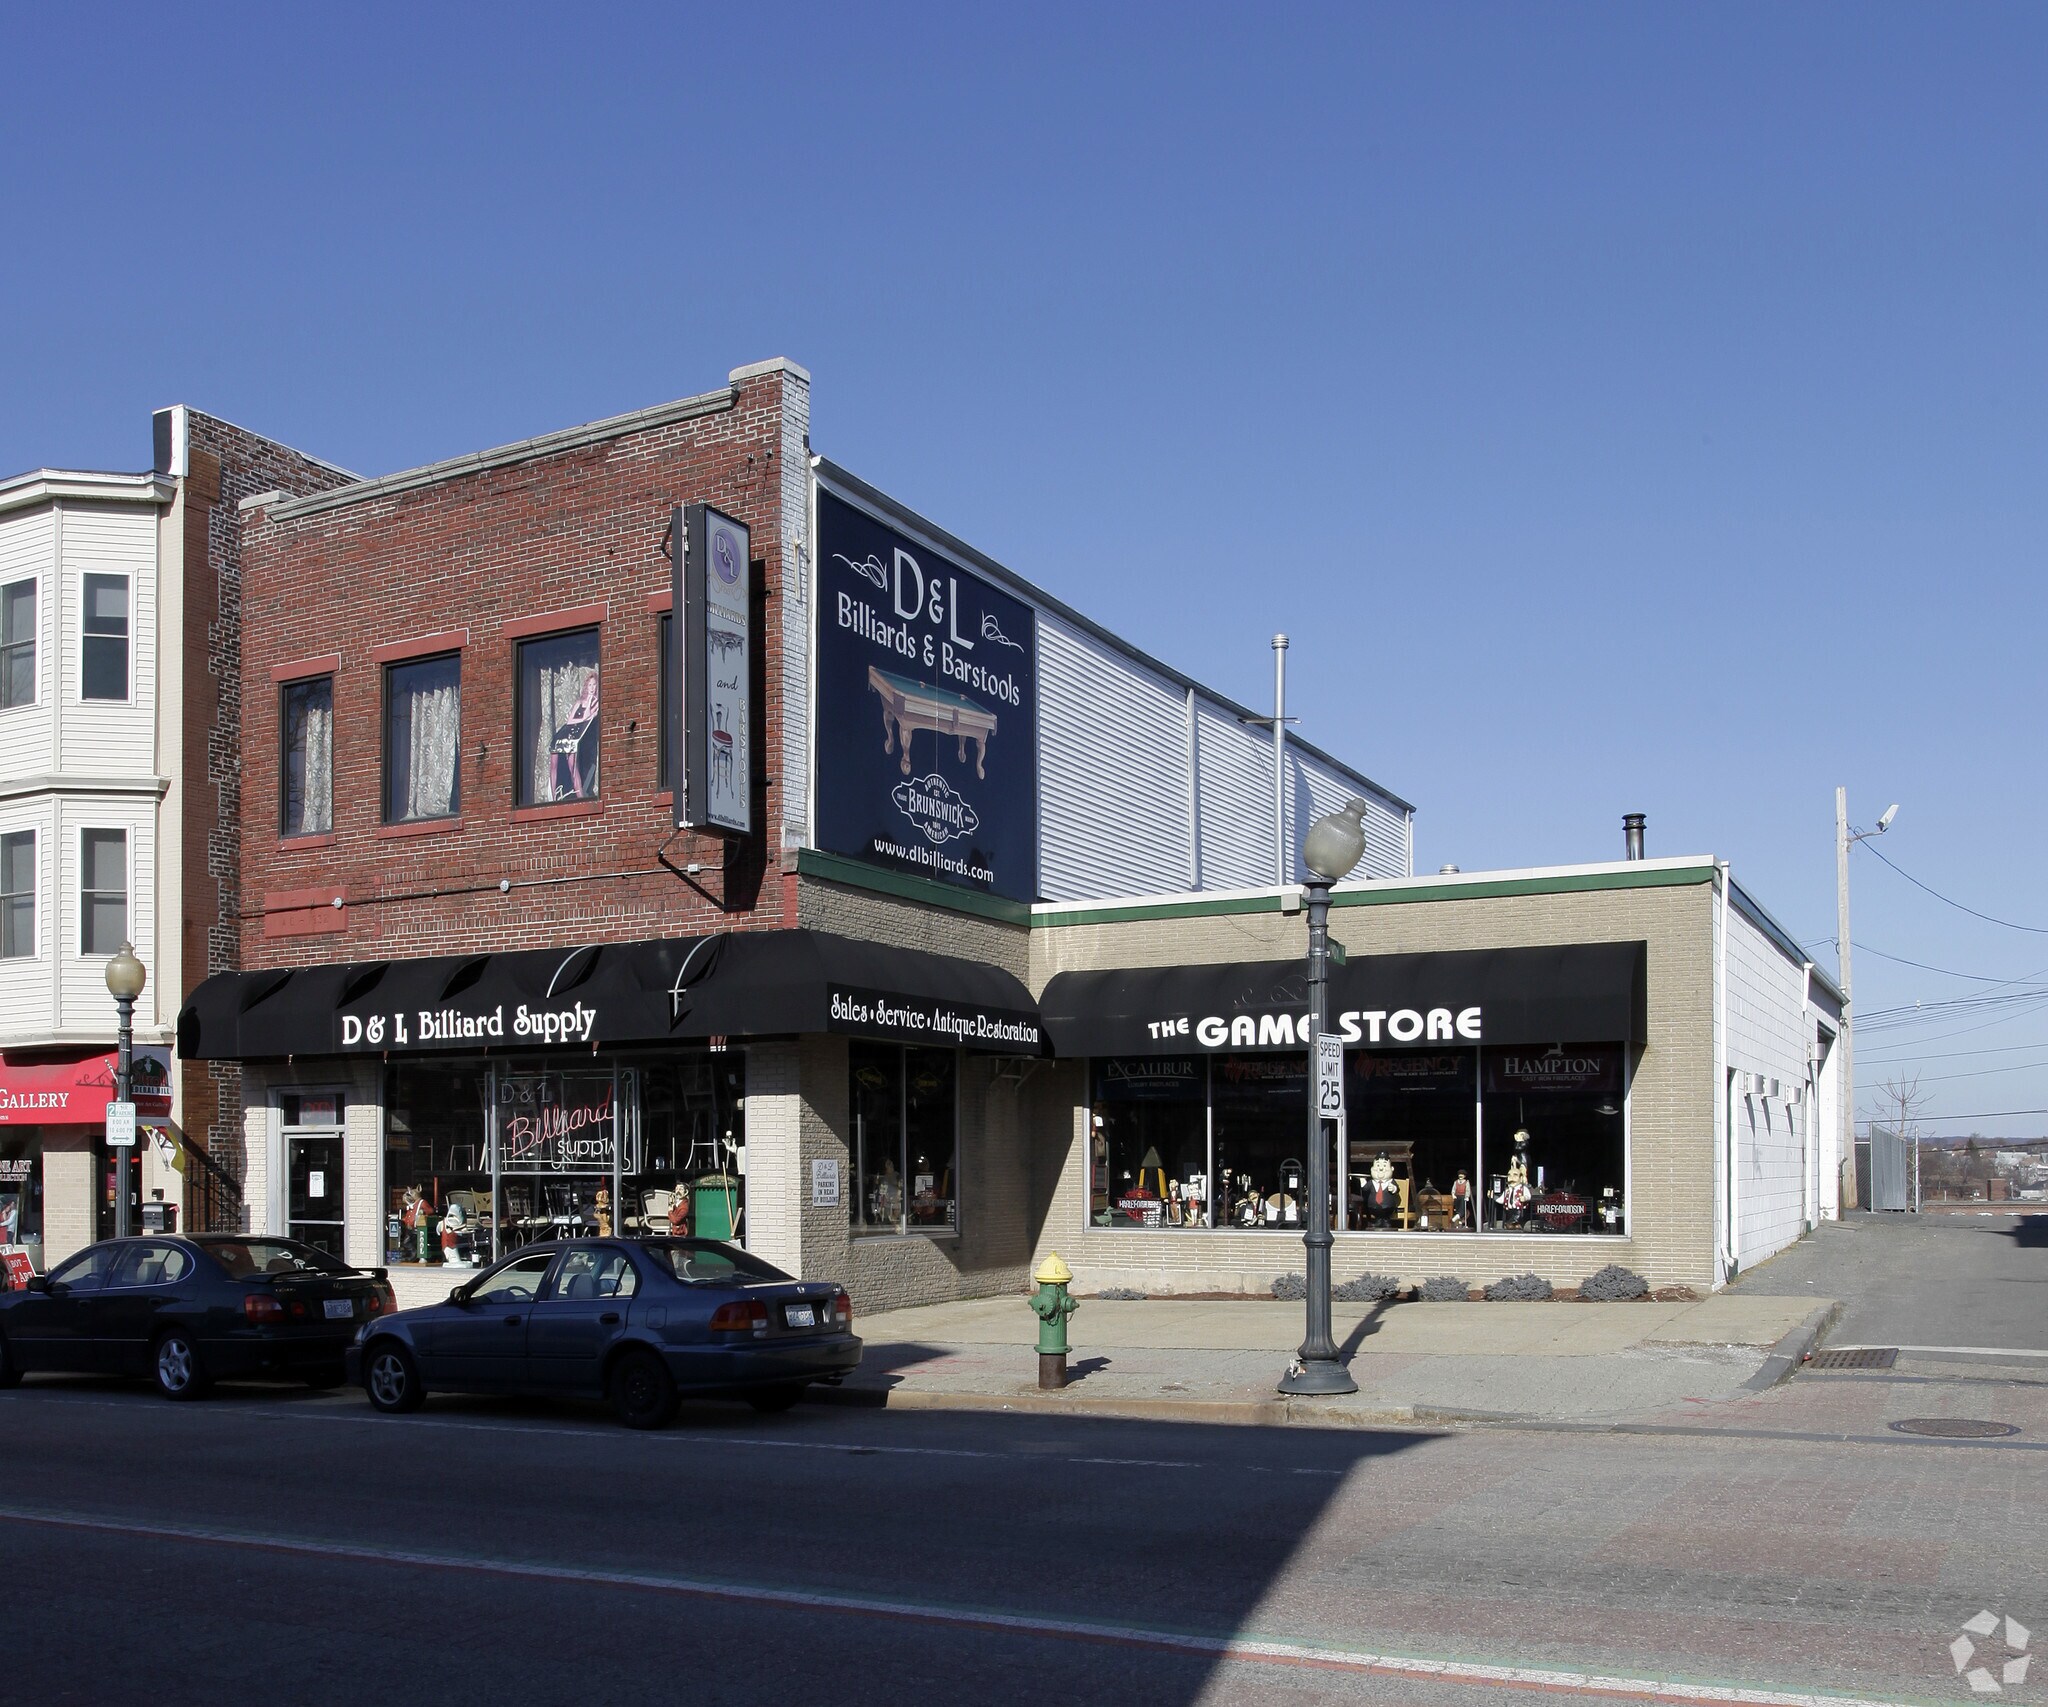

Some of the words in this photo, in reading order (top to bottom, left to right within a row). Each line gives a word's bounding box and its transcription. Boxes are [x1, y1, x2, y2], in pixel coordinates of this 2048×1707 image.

[838, 591, 916, 659] Billiards
[923, 634, 935, 667] &
[942, 641, 1020, 706] Barstools
[716, 675, 738, 691] and
[738, 697, 747, 809] BARSTOOLS
[908, 787, 965, 829] BRUNSWICK
[923, 821, 949, 840] AMERICAN
[874, 839, 994, 882] www.dlbilliards.com
[342, 1016, 363, 1045] D
[366, 1014, 386, 1045] &
[394, 1013, 408, 1045] L
[418, 1004, 504, 1040] Billiard
[513, 1001, 597, 1044] Supply
[830, 993, 868, 1023] Sales
[876, 999, 925, 1029] Service
[932, 1008, 976, 1042] Antique
[977, 1014, 1039, 1044] Restoration
[1147, 1017, 1190, 1040] THE
[1338, 1006, 1482, 1043] STORE
[1319, 1041, 1341, 1058] SPEED
[1107, 1059, 1194, 1081] EXCALIBUR
[1321, 1062, 1339, 1078] LIMIT
[1374, 1056, 1461, 1077] REGENCY
[1504, 1057, 1601, 1074] HAMPTON
[0, 1089, 70, 1109] GALLERY
[1320, 1079, 1341, 1110] 25
[108, 1105, 115, 1116] 2
[506, 1082, 614, 1158] Billiard
[12, 1160, 32, 1173] ART
[1537, 1204, 1585, 1214] HARLEY-DAVIDSON
